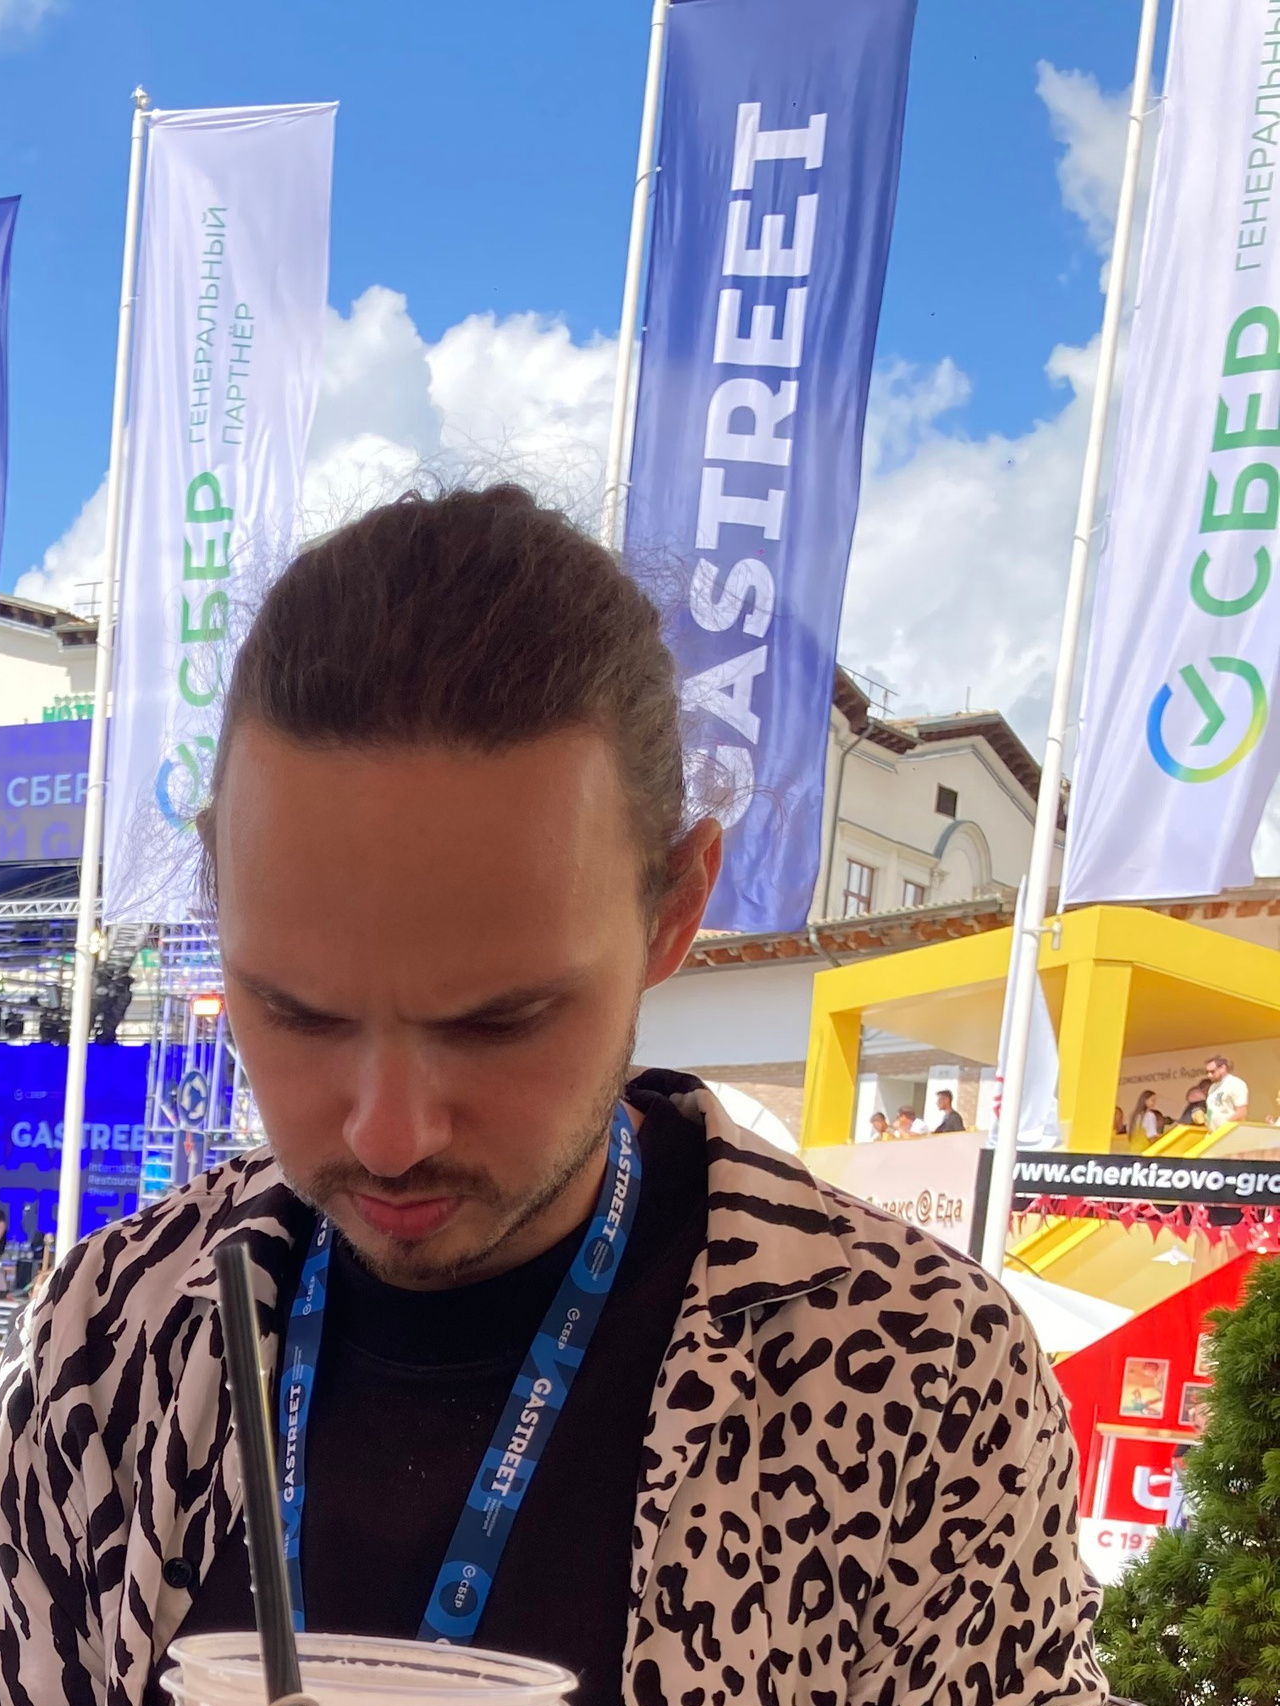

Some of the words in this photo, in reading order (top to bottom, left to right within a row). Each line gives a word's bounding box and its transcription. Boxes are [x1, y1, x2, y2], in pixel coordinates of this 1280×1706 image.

[1234, 0, 1280, 272] ГЕНЕРАЛЬНЫ
[188, 206, 229, 444] ГЕНЕРАЛЬНЫЙ
[221, 301, 256, 445] ПАРТНЁР
[1189, 305, 1280, 618] СБЕР
[178, 470, 235, 714] СБЕР
[6, 772, 89, 808] СБЕР
[10, 1120, 145, 1151] GASTREE
[88, 1162, 140, 1173] Internatio
[88, 1175, 139, 1186] Restauran
[601, 1127, 632, 1243] GASTREET
[936, 1192, 963, 1228] Еда
[283, 1384, 302, 1503] GASTREET
[491, 1377, 553, 1496] GASTREET
[454, 1579, 470, 1608] СБЕР
